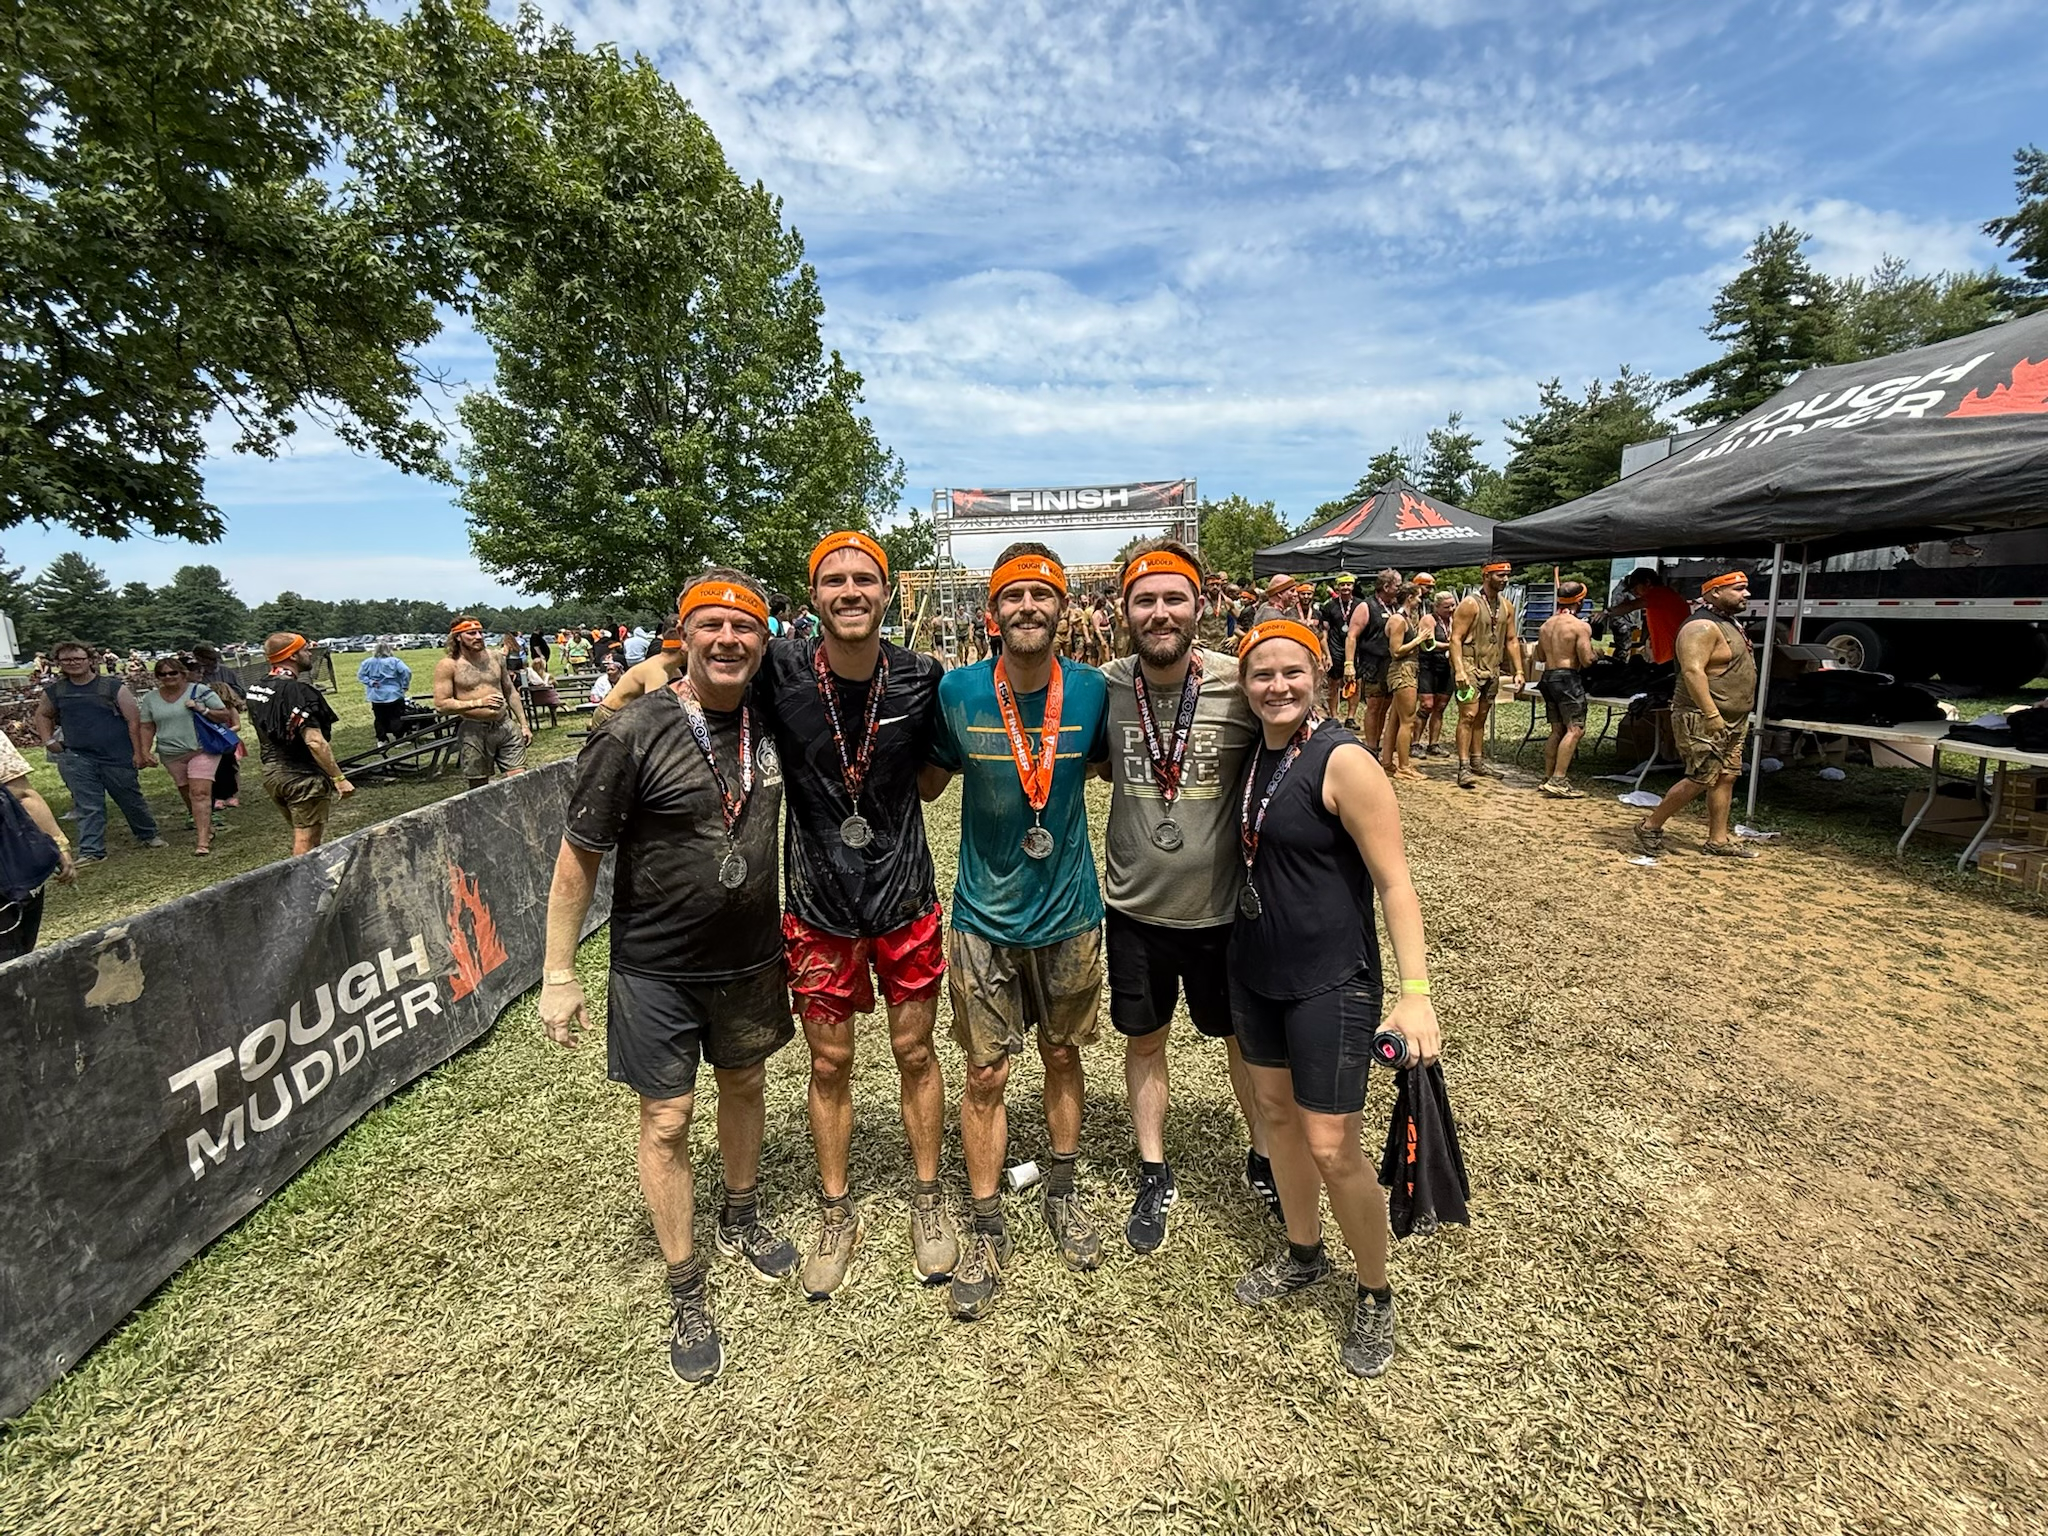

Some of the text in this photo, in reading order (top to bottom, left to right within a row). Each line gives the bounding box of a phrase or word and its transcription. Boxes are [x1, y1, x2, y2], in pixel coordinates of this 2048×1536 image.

[1719, 351, 1995, 443] TOUGH
[1009, 487, 1129, 512] FINISH
[1388, 526, 1477, 539] TOUGH
[1396, 531, 1483, 541] MUDDER
[1016, 561, 1040, 571] TOUGH
[699, 589, 724, 598] TOUGH
[998, 681, 1030, 771] 15K FINISHER
[1178, 674, 1200, 727] 2025
[1122, 726, 1218, 757] PE
[1138, 698, 1162, 761] FINISHER
[741, 729, 753, 792] FINISHER
[168, 934, 431, 1115] TOUGH
[186, 981, 443, 1182] MUDDER
